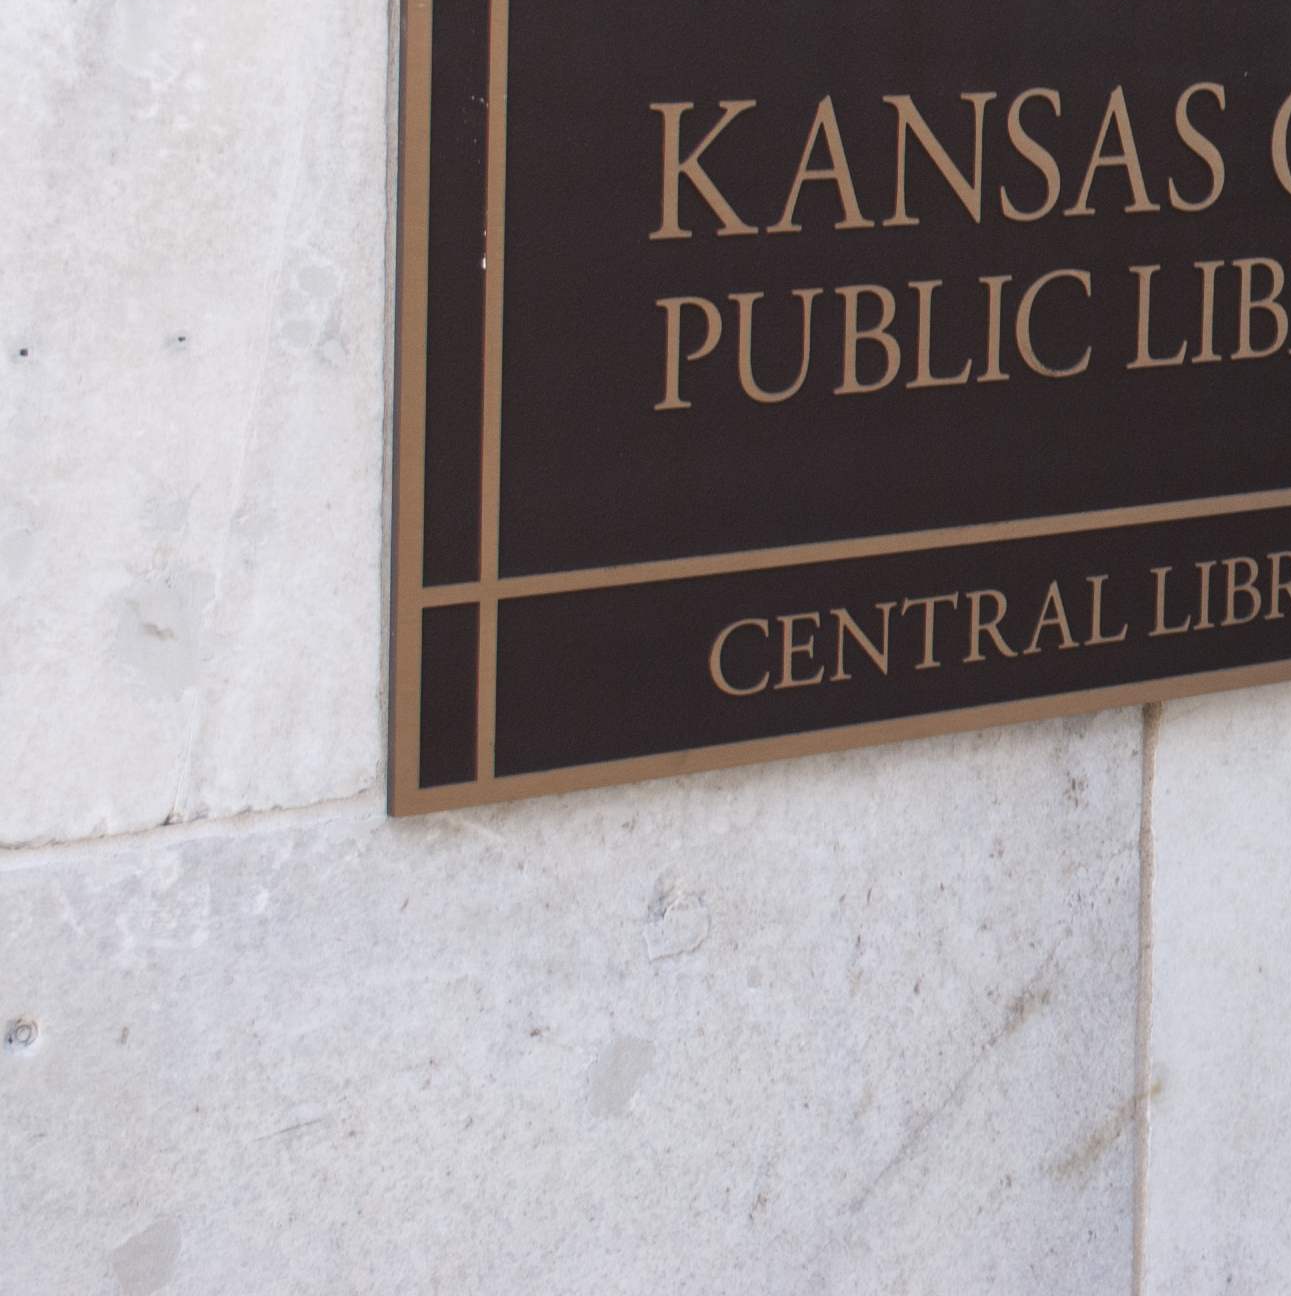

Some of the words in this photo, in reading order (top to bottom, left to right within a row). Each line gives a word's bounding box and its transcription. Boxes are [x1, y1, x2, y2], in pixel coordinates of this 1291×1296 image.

[649, 81, 1226, 240] KANSAS
[653, 268, 1092, 411] PUBLIC
[708, 574, 1128, 696] CENTRAL
